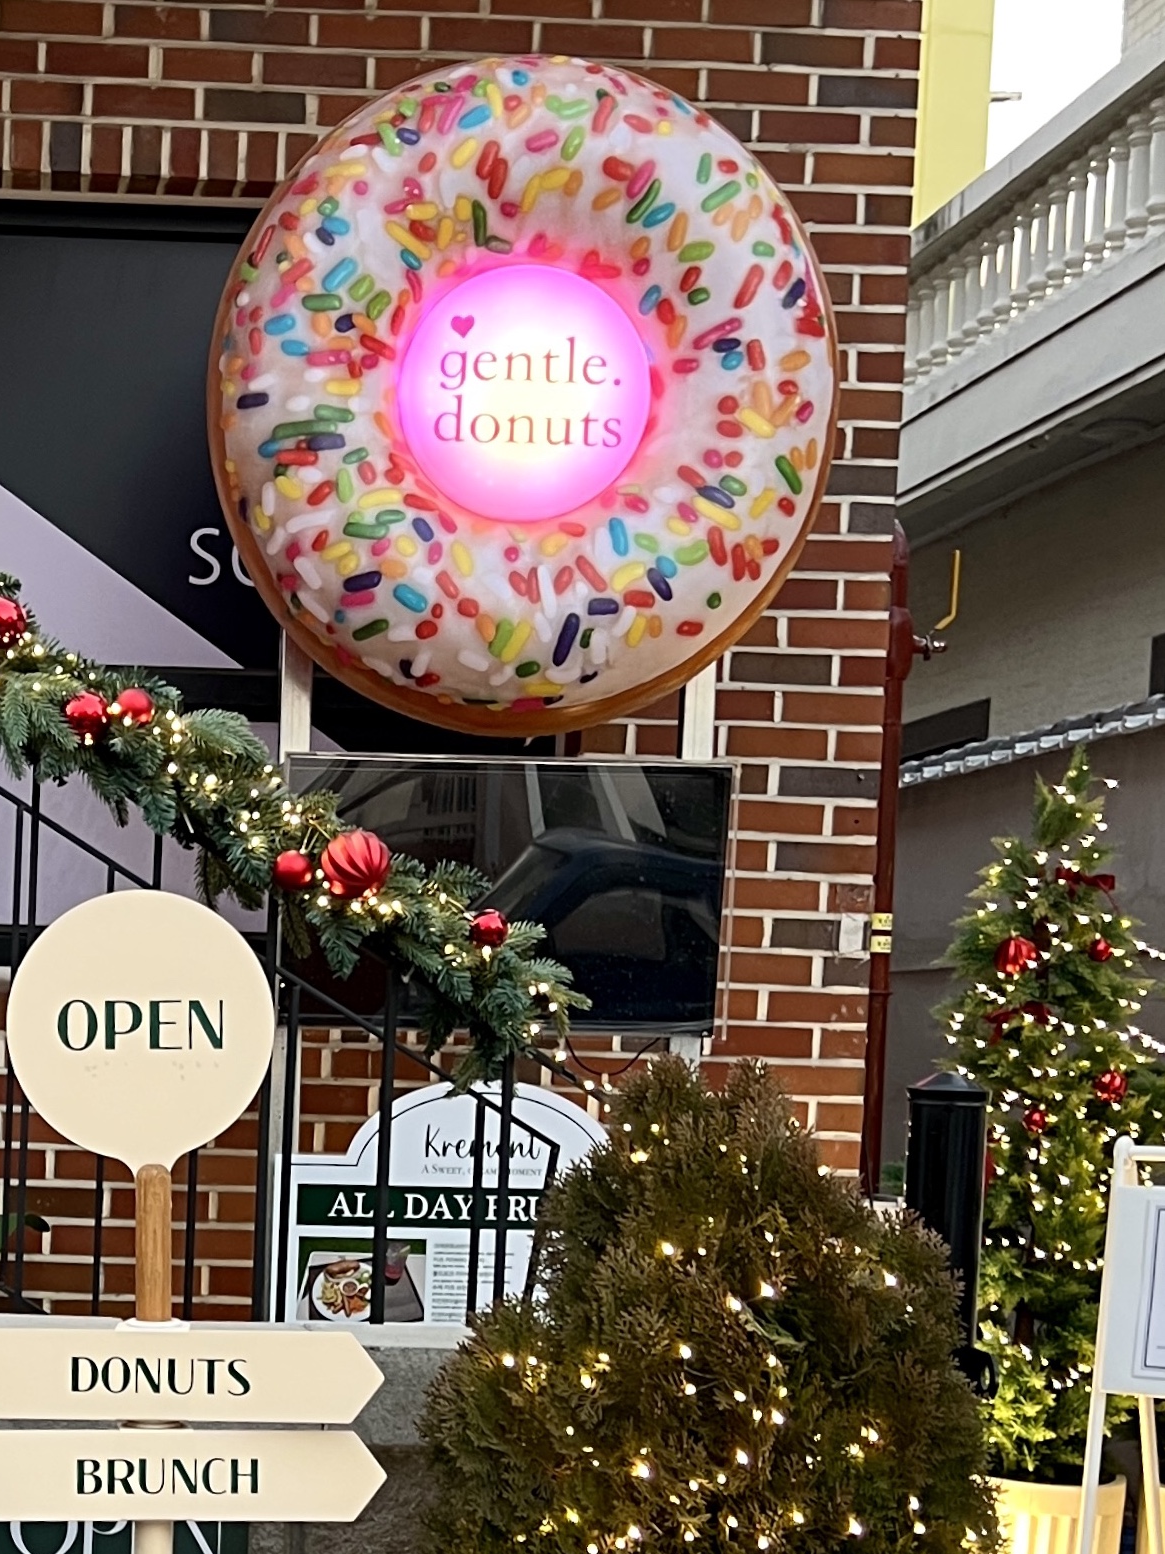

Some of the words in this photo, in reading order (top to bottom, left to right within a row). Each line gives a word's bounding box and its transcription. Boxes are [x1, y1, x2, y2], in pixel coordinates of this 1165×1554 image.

[440, 336, 621, 390] gentle.
[434, 394, 622, 448] donuts
[57, 999, 224, 1051] OPEN
[404, 1193, 474, 1220] DAY
[70, 1356, 251, 1396] DONUTS
[76, 1458, 259, 1495] BRUNCH
